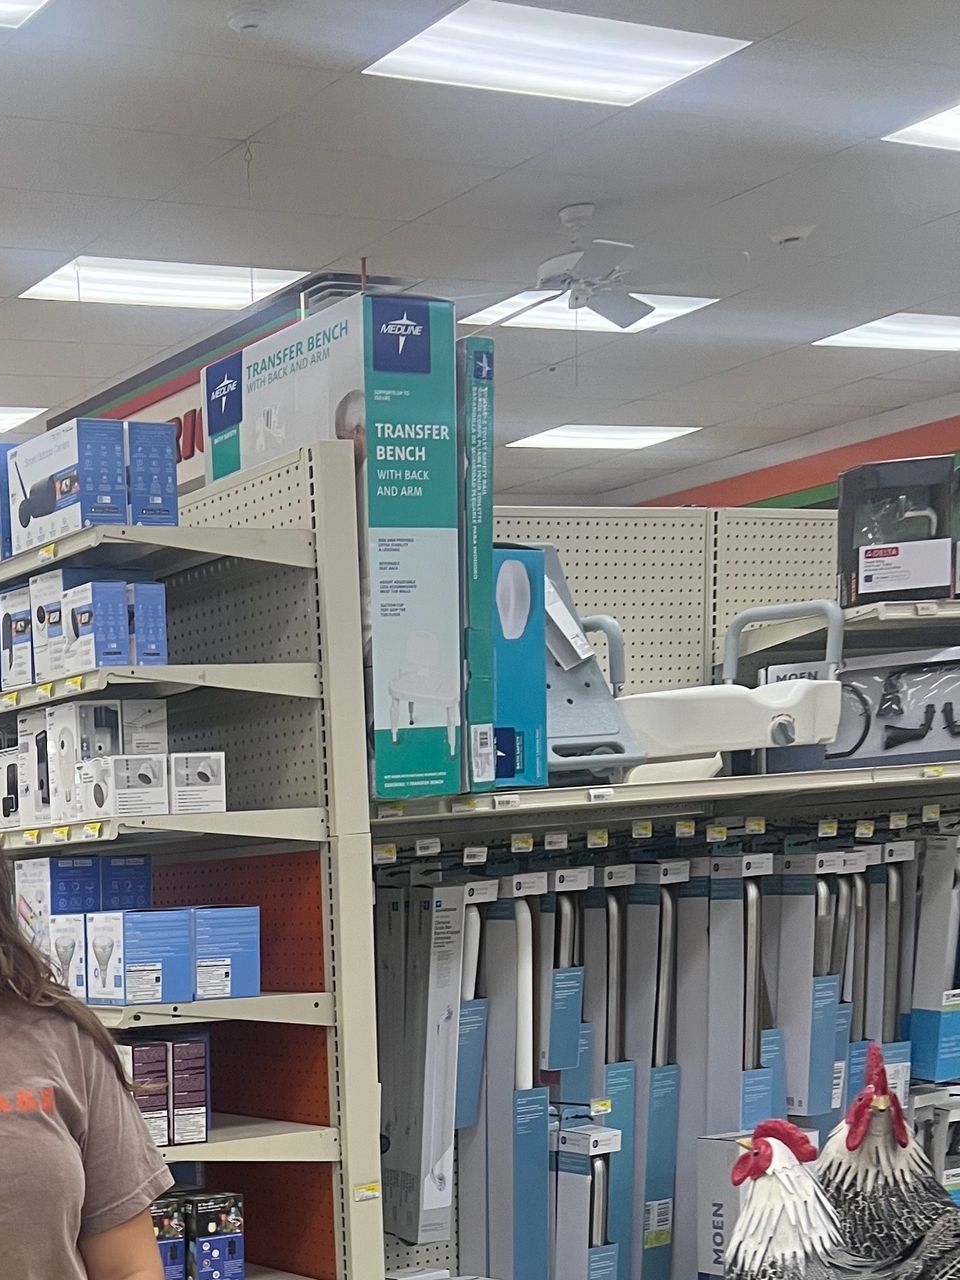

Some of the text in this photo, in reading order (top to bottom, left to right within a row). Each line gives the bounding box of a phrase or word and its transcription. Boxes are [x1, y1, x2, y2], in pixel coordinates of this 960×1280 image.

[380, 323, 424, 336] MEDLINE
[246, 319, 348, 380] TRANSFER BENCH
[246, 348, 330, 394] WITH BACK AND ARM
[210, 380, 238, 400] MEDLINE
[375, 423, 450, 441] TRANSFER
[376, 446, 426, 461] BENCH
[377, 469, 430, 481] WITH BACK
[377, 486, 423, 497] AND ARM
[711, 1202, 725, 1265] MOEN
